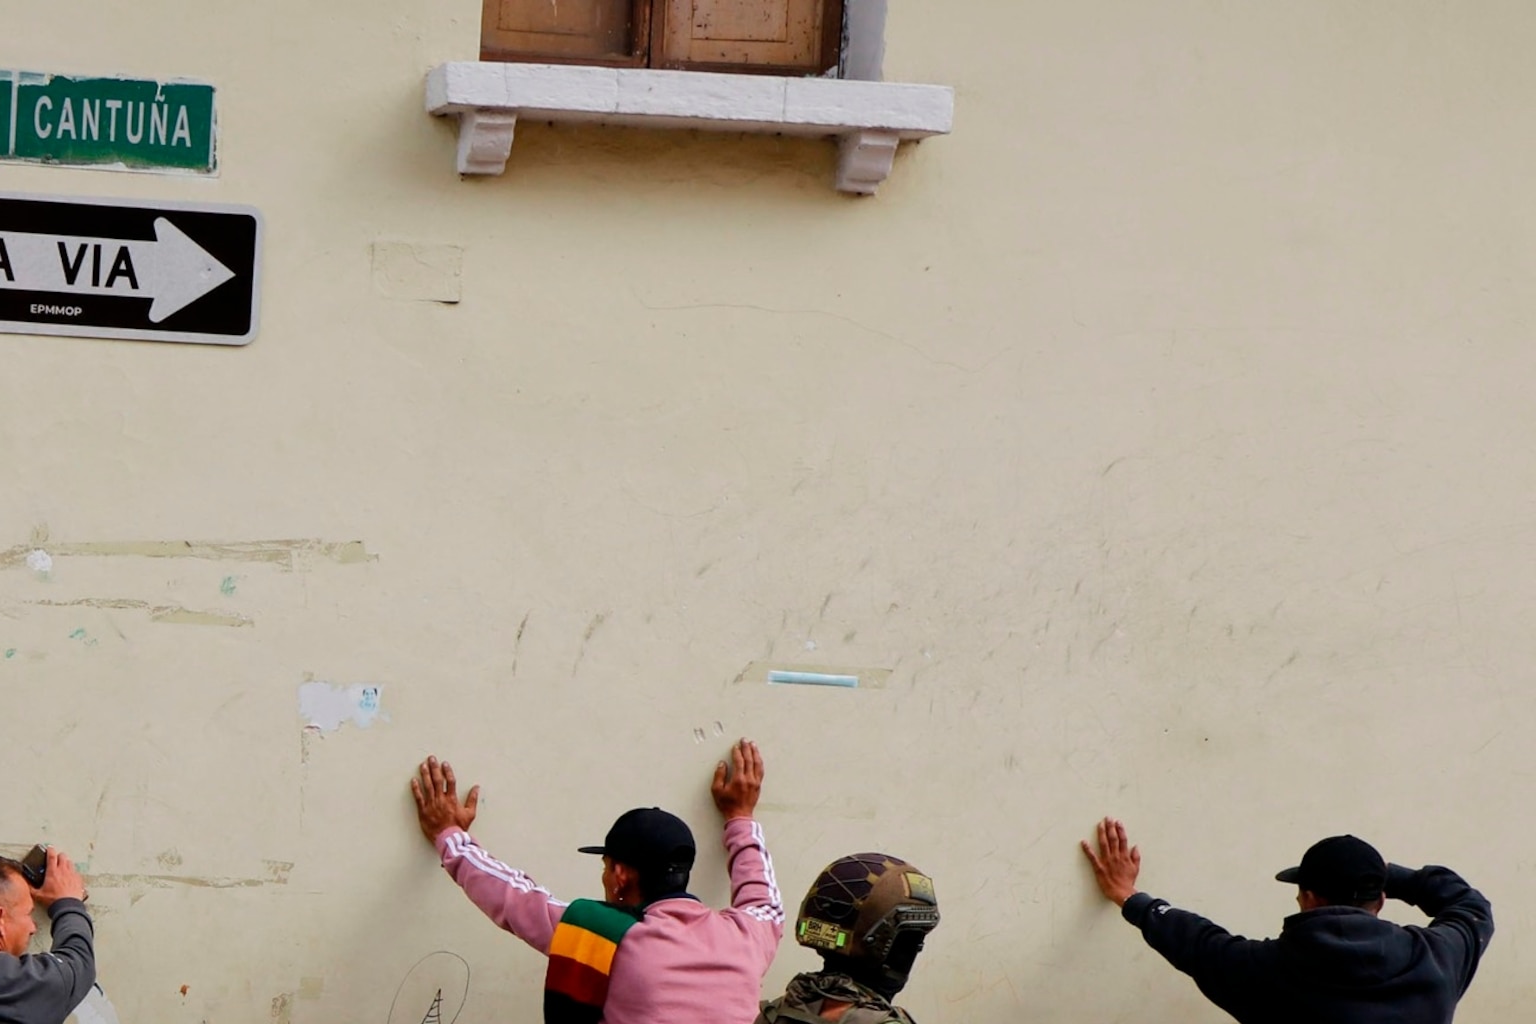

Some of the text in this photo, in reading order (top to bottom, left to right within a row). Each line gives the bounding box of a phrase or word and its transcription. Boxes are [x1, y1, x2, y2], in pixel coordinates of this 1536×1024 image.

[33, 94, 192, 148] CANTUÑA
[57, 241, 140, 290] VIA
[30, 303, 83, 316] EPMMOP
